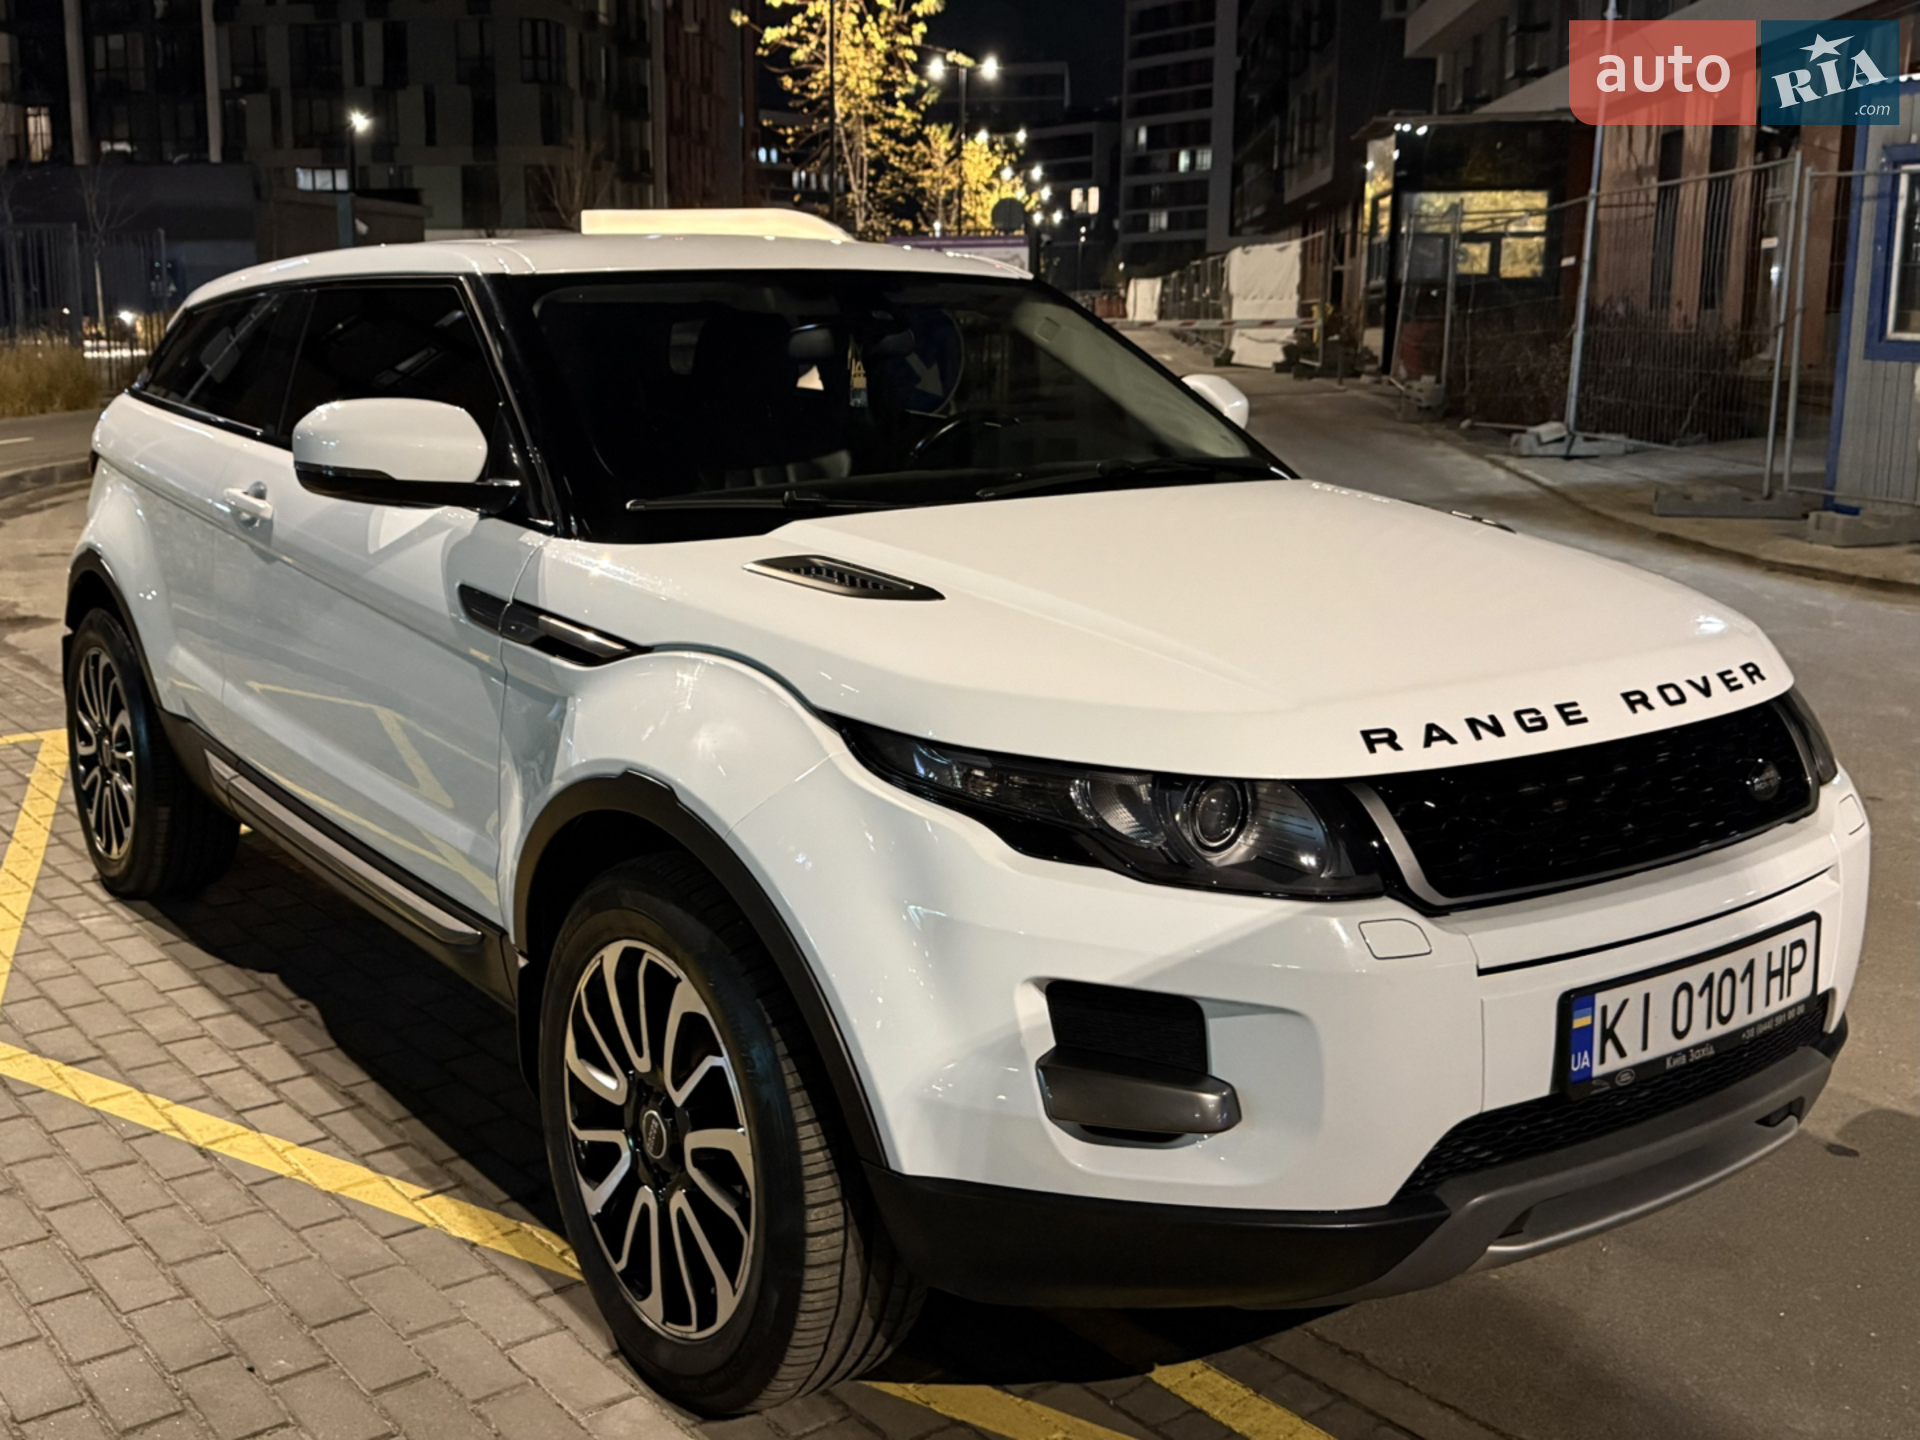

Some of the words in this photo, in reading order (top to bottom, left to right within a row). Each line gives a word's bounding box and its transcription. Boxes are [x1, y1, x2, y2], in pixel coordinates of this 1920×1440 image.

[1359, 700, 1589, 754] RANGE
[1620, 661, 1766, 715] ROVER
[1598, 992, 1650, 1066] KI
[1671, 957, 1755, 1040] 0101
[1765, 938, 1807, 1008] HP
[1571, 1051, 1591, 1072] UA
